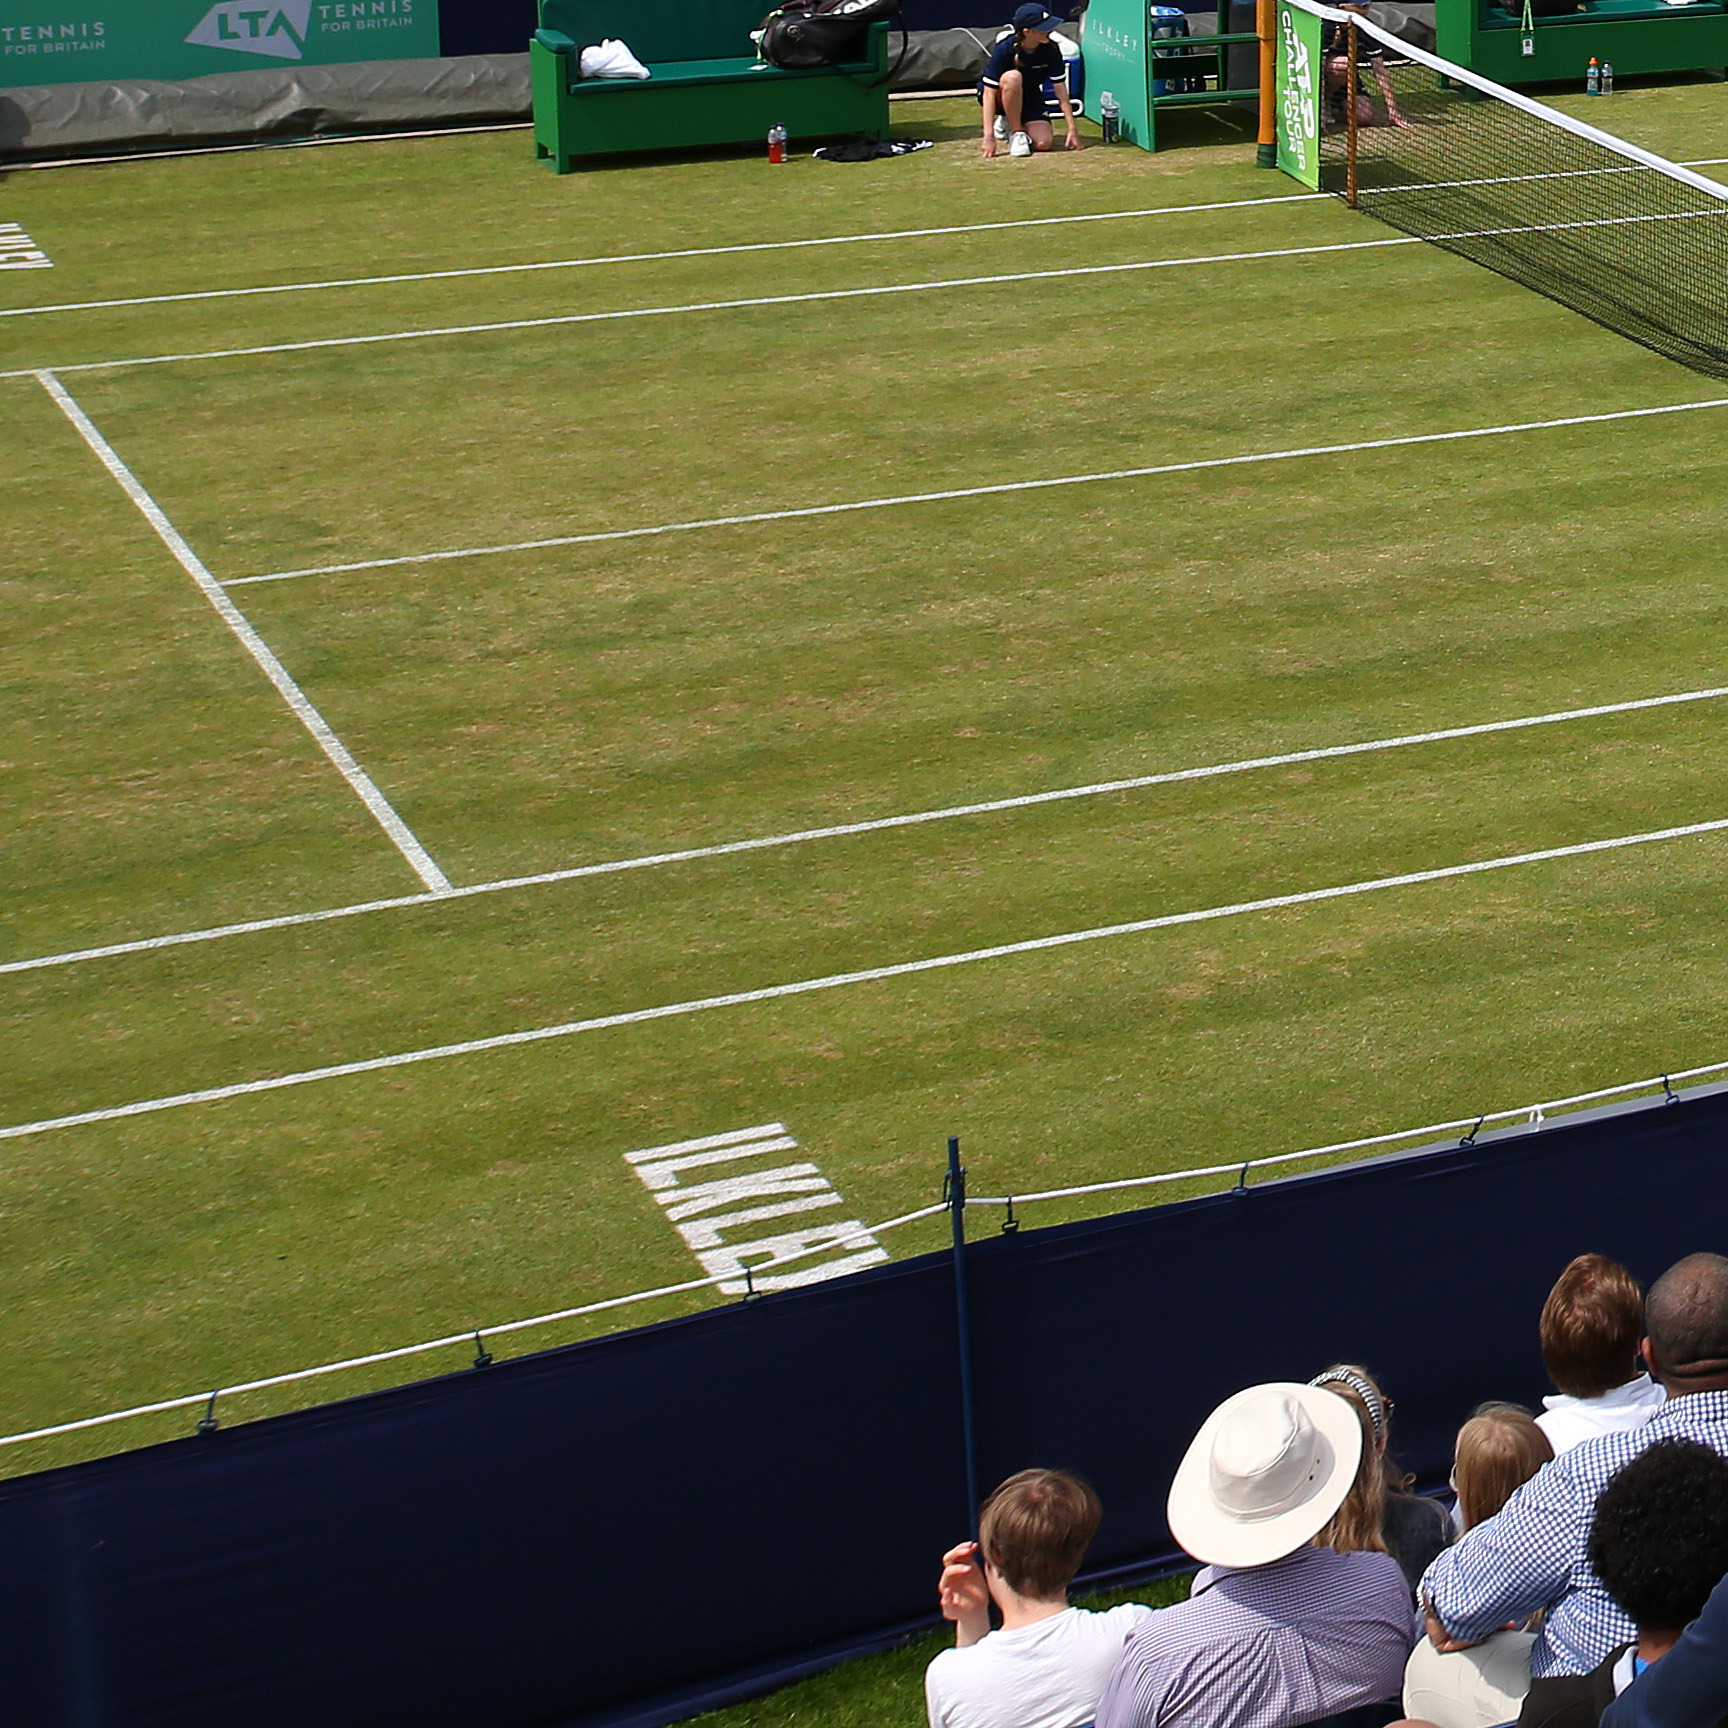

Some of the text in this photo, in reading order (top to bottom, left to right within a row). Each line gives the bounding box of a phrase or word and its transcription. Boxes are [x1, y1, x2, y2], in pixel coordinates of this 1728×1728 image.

[2, 21, 106, 42] TENNIS
[217, 0, 414, 41] LTA TENNIS
[321, 16, 413, 32] FOR BRITAIN
[1092, 18, 1137, 51] ILKLEY
[5, 39, 106, 55] FOR BRITAIN
[1281, 9, 1307, 172] CHALLENGER
[1293, 32, 1315, 139] ATP
[1282, 88, 1298, 154] TOUR
